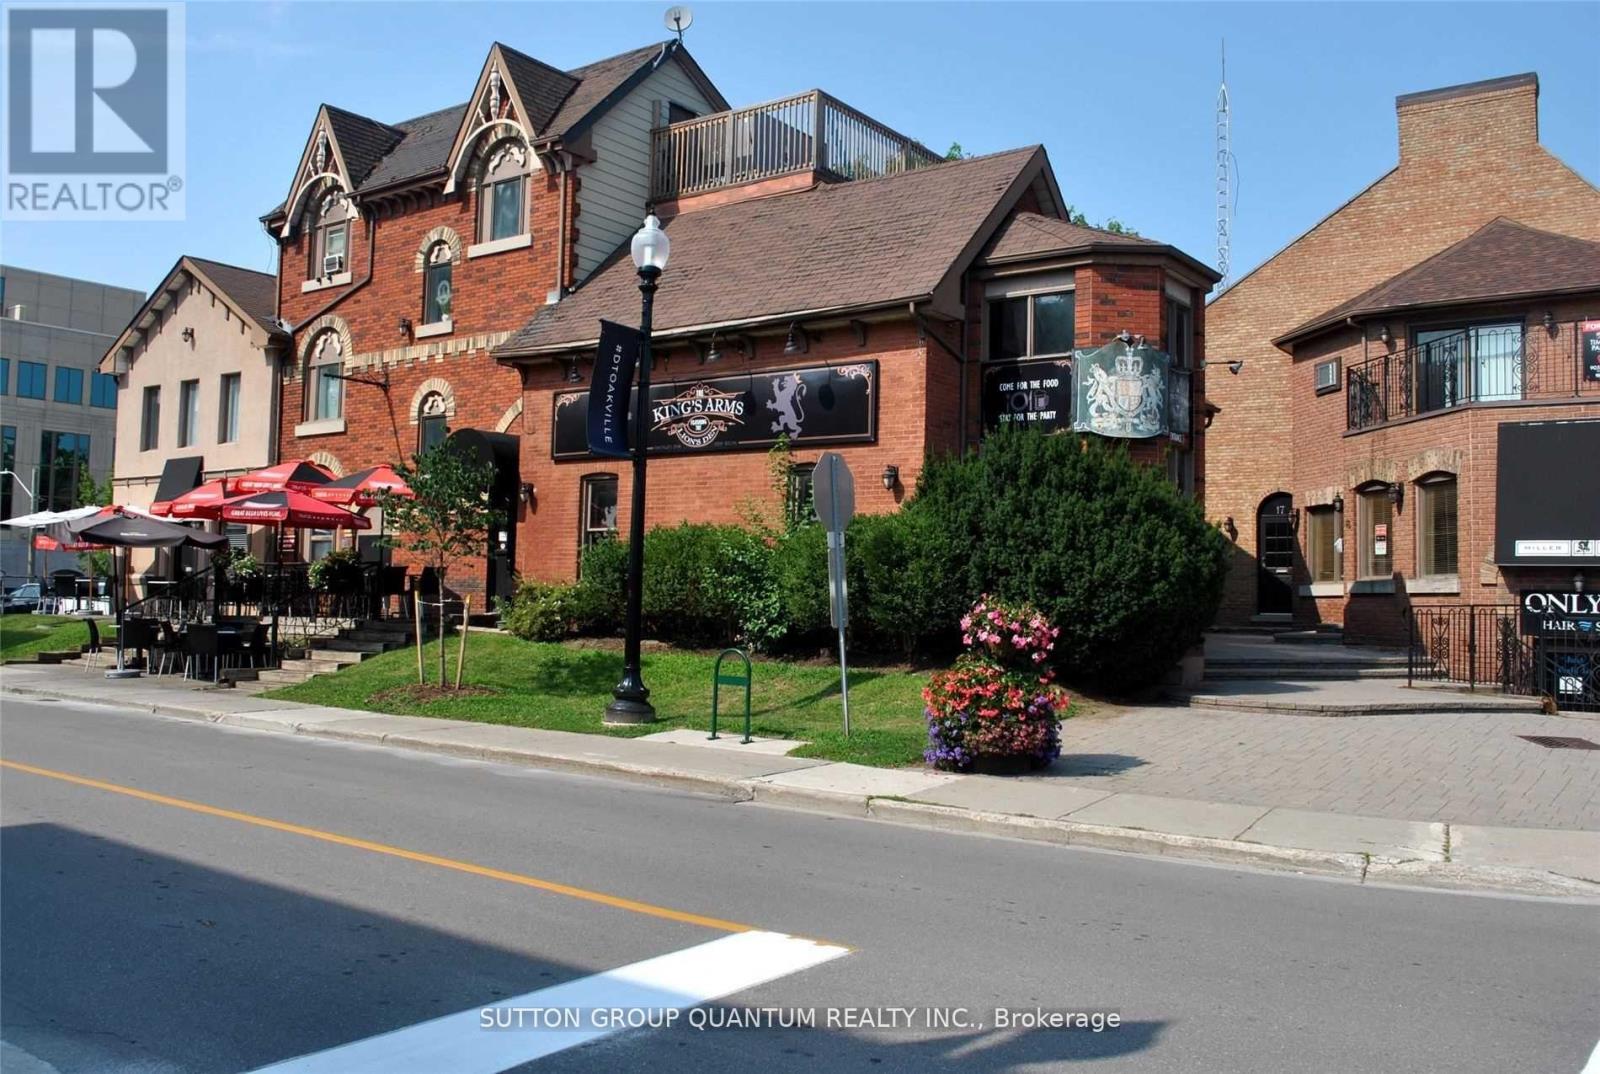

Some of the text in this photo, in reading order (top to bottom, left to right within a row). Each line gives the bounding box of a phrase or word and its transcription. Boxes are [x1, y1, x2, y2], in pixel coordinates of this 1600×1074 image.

[999, 379, 1059, 391] COME FOR THE FOOD
[604, 344, 623, 443] #DTOAKVILLE
[652, 398, 744, 422] KING'S ARMS
[1027, 412, 1037, 421] THE
[1040, 411, 1056, 420] PARTY
[678, 428, 701, 446] LION'S
[703, 425, 718, 444] DEN
[1276, 505, 1285, 515] 17
[1525, 593, 1600, 614] ONLY
[1542, 620, 1576, 631] HAIR
